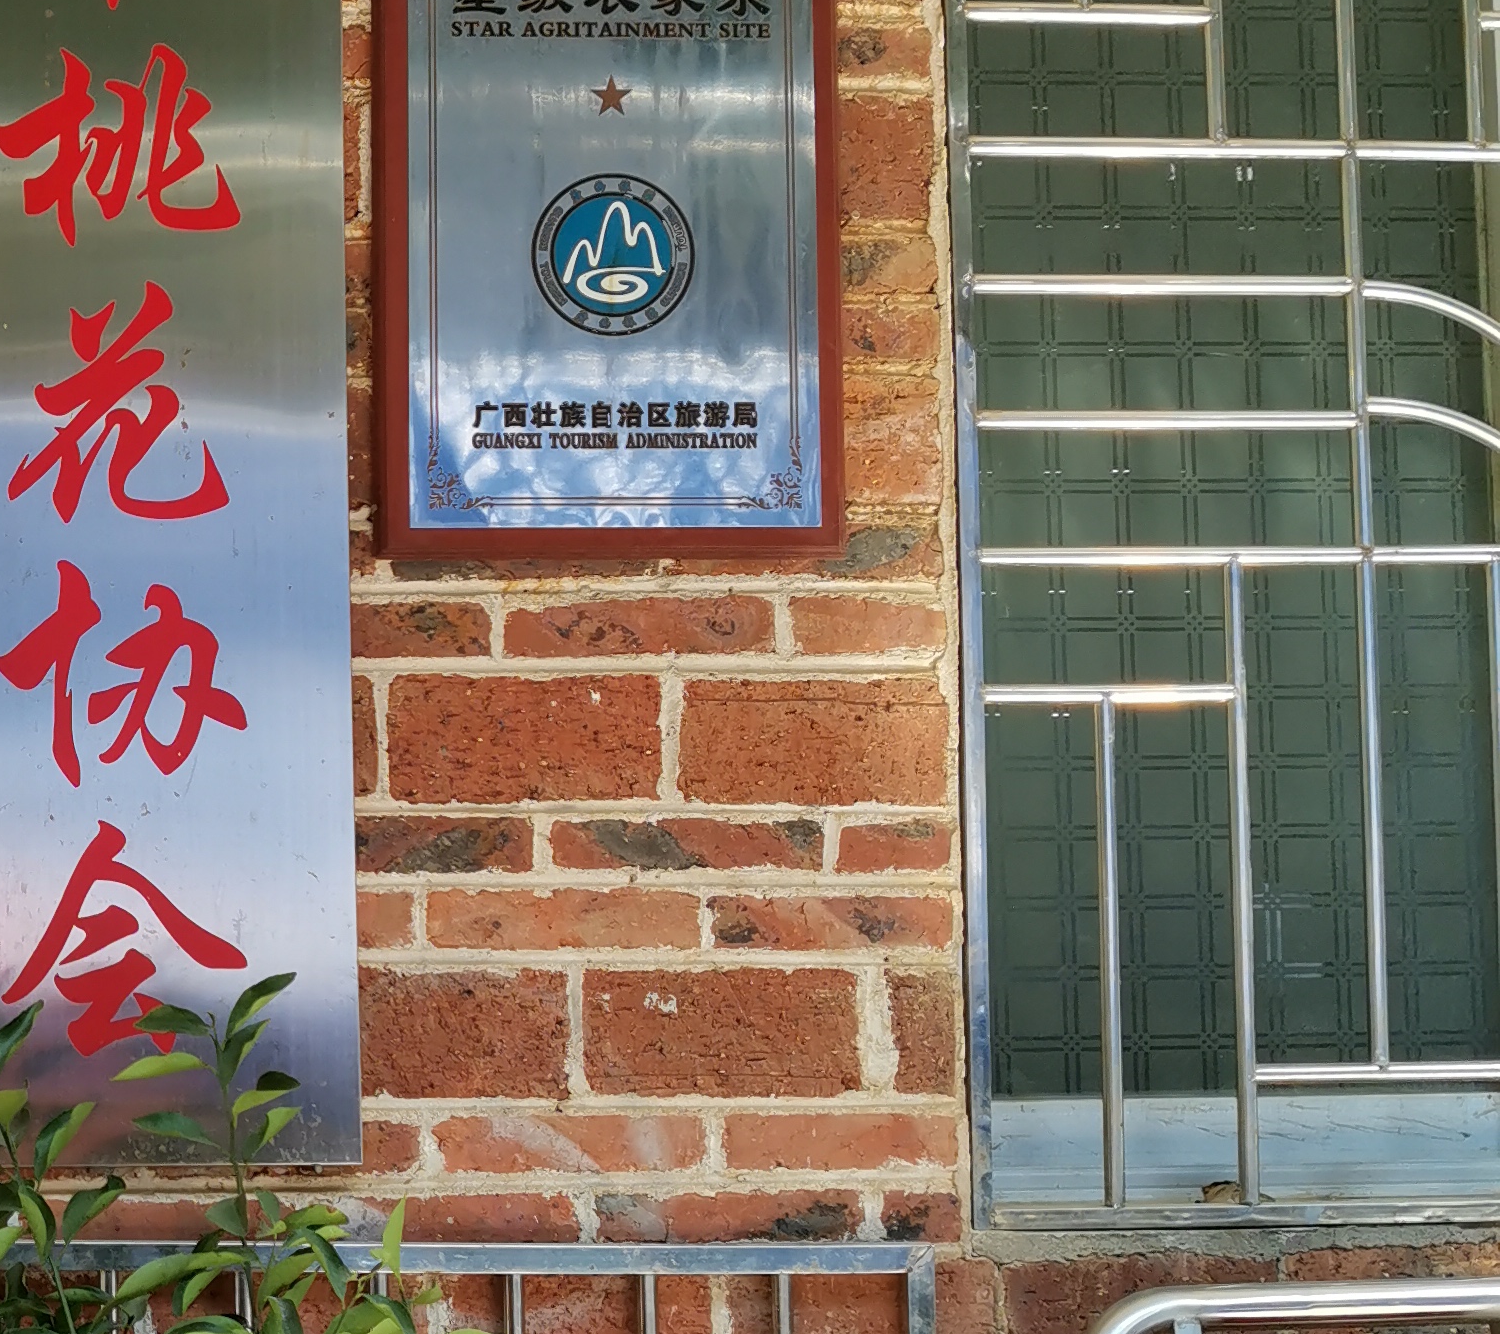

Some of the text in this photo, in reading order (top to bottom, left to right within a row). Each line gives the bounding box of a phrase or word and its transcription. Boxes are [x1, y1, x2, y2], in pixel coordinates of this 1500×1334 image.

[451, 21, 771, 40] STAR AGRITAINMENT SITE
[472, 401, 758, 429] 广西壮族自治区旅游局
[471, 432, 758, 450] GUANGXI TOURISM ADMINISTRATION
